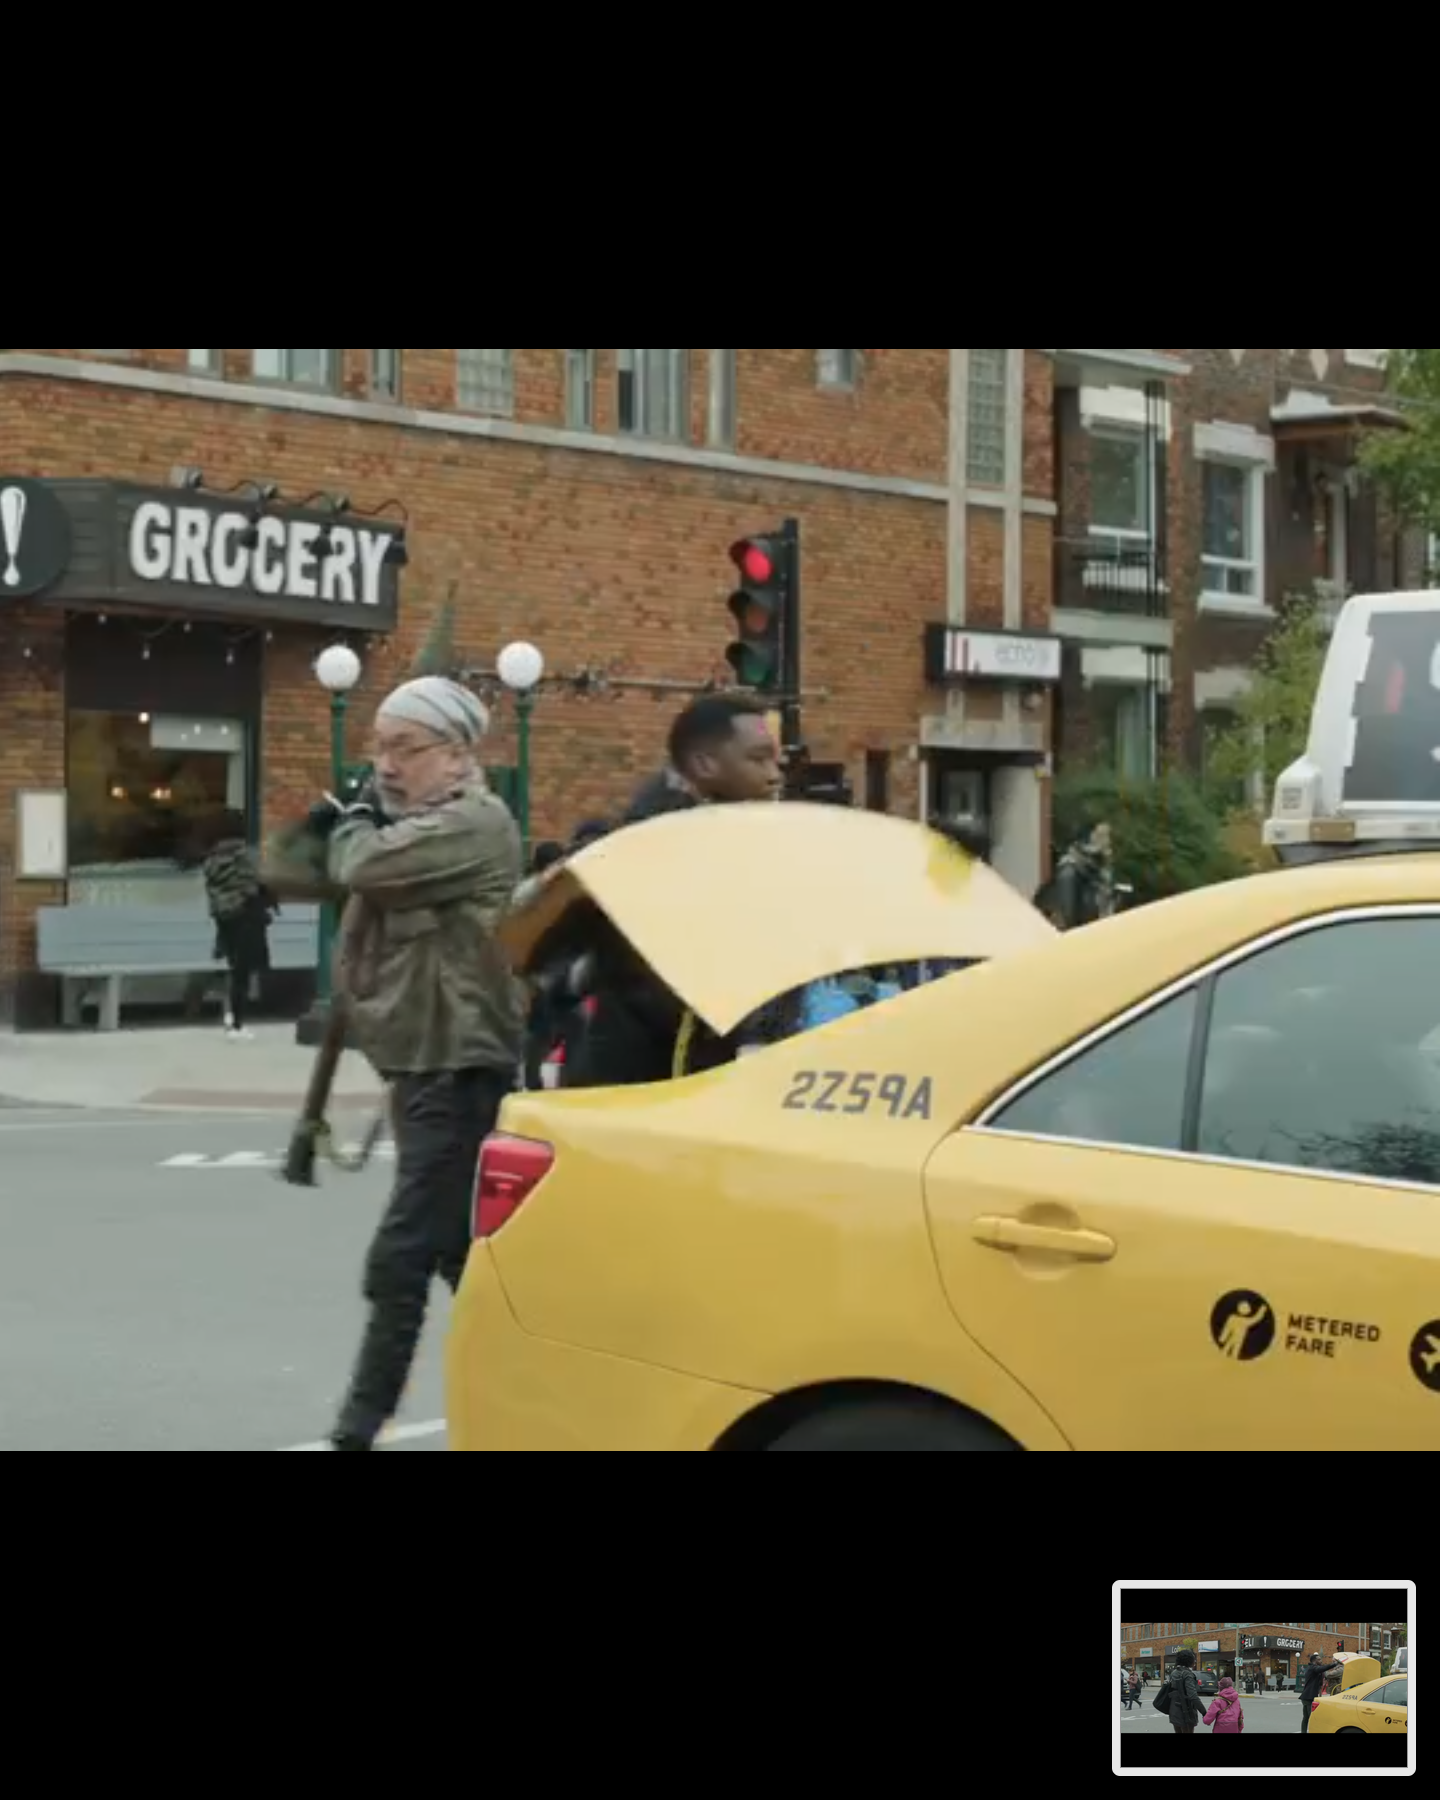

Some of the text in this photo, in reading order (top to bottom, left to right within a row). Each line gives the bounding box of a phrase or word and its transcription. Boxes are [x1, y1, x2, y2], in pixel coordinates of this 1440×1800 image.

[129, 501, 393, 605] GROCERY
[781, 1070, 932, 1120] 2Z59A
[1285, 1335, 1336, 1358] FARE
[1287, 1314, 1381, 1342] METERED
